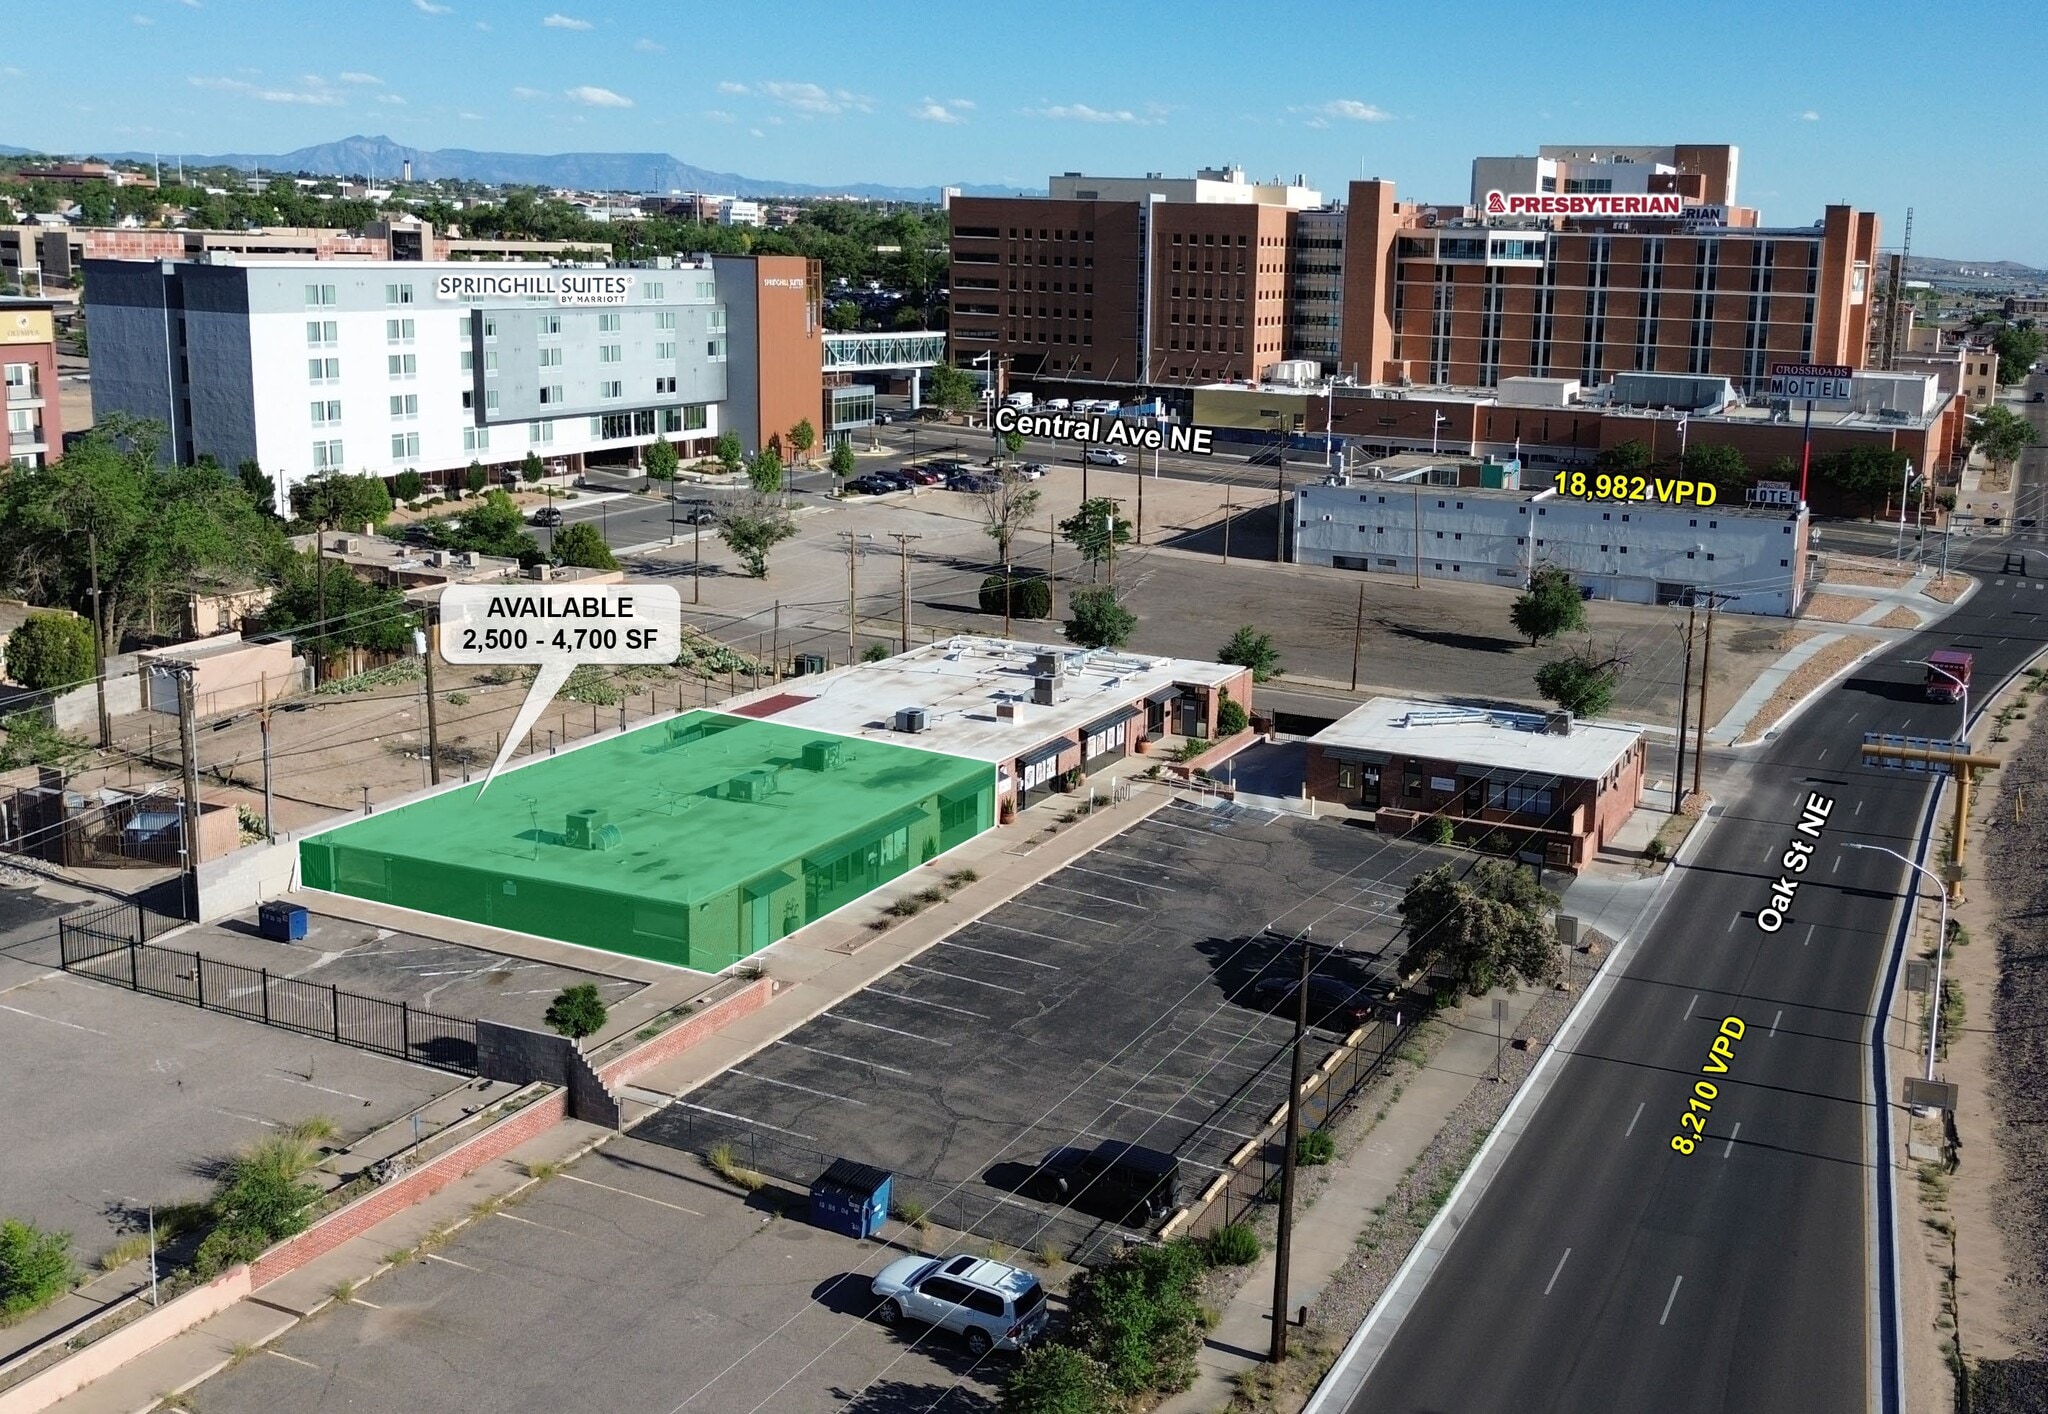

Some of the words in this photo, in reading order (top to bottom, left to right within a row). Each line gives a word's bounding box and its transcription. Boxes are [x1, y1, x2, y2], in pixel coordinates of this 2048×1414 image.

[1775, 365, 1848, 377] CROSSROADS
[1771, 379, 1848, 397] MOTEL
[1748, 490, 1798, 503] MOTEL
